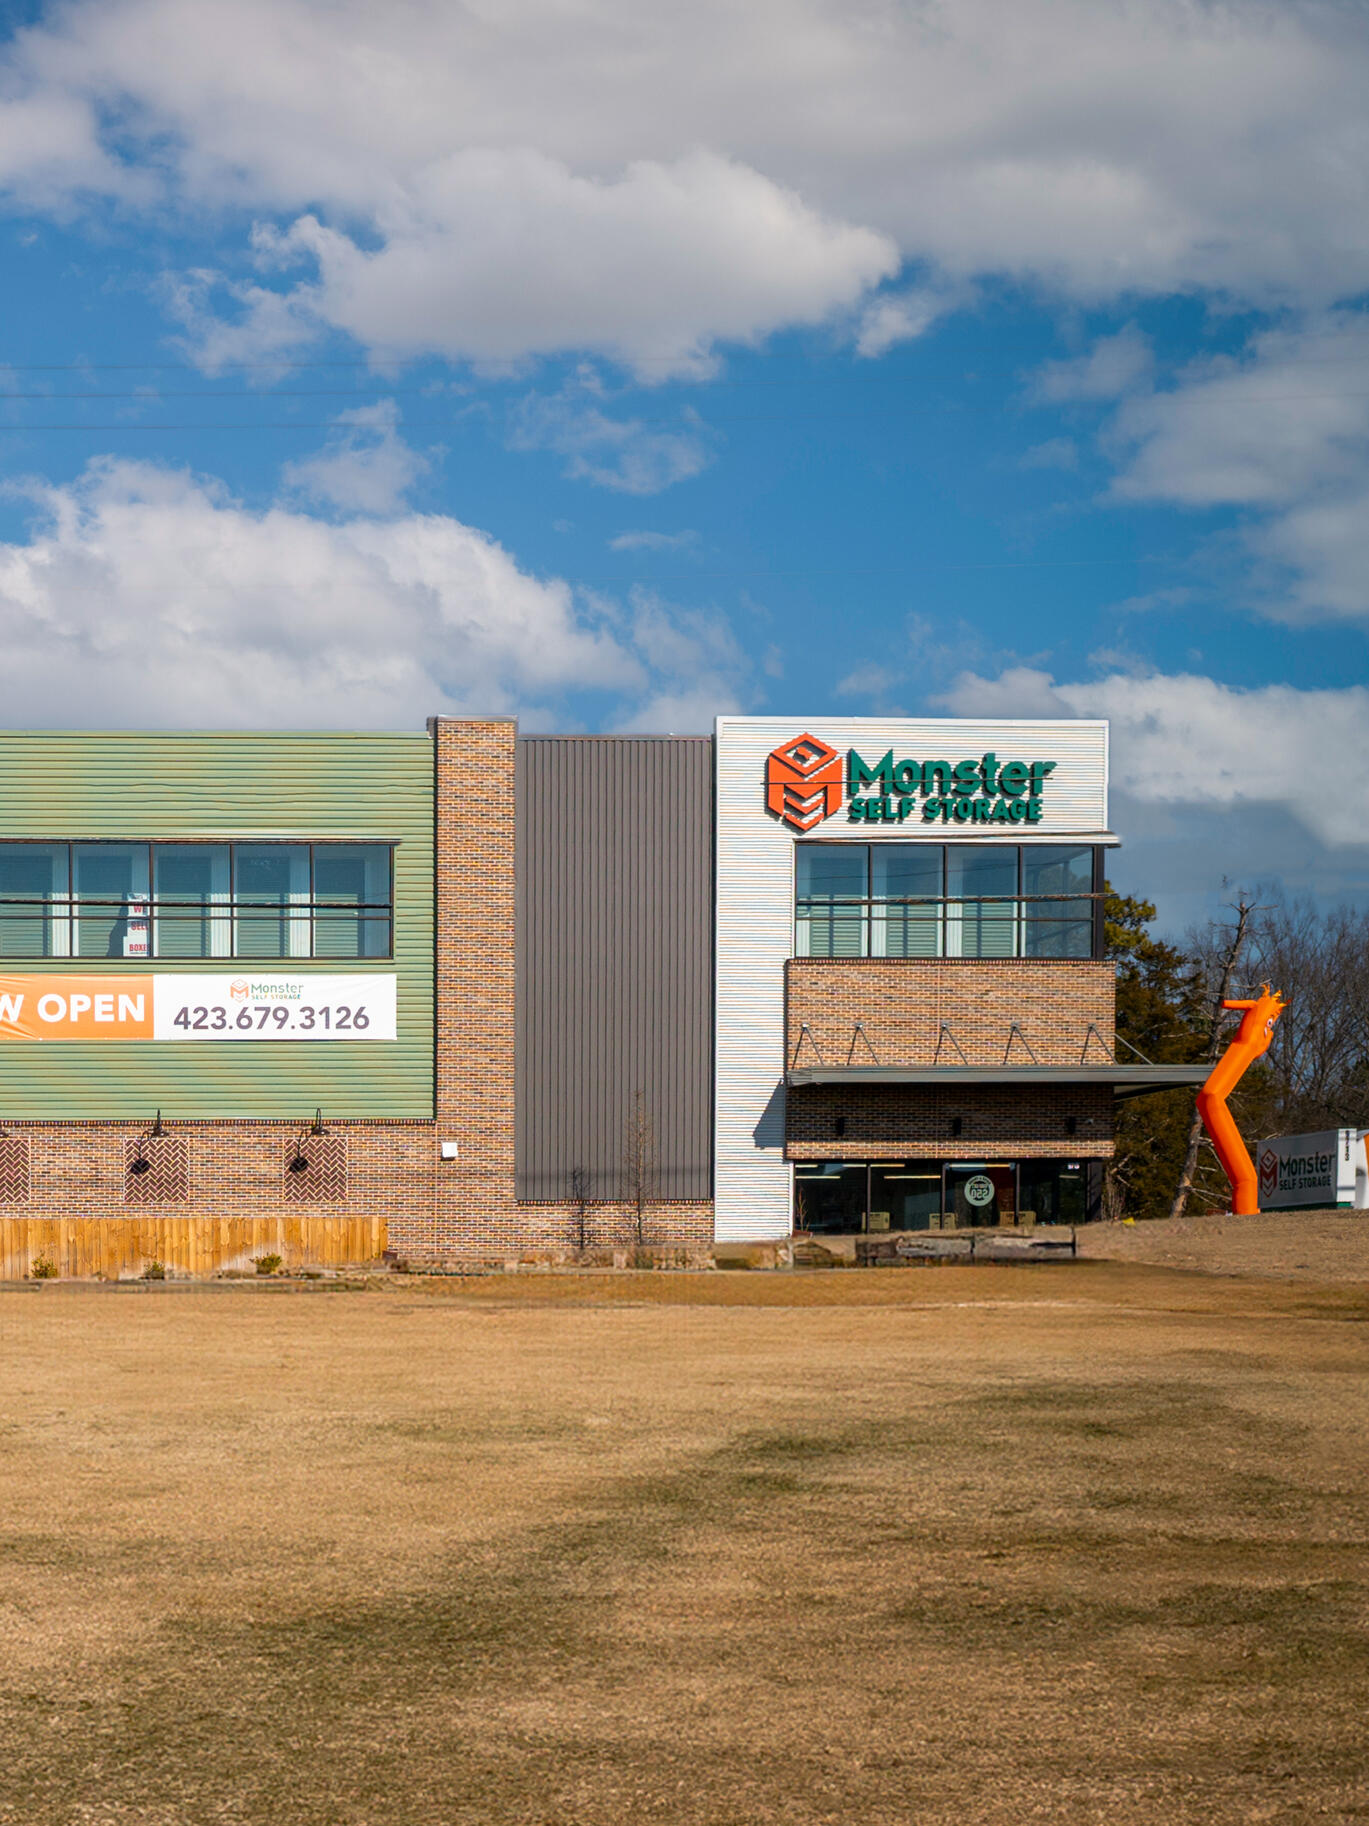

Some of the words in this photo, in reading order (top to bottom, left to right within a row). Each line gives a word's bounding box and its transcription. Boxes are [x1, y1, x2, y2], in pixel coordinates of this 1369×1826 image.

[849, 748, 1058, 796] Monster
[850, 797, 917, 820] SELF
[924, 797, 1044, 821] STORAGE
[250, 982, 304, 994] Monster
[37, 993, 145, 1022] OPEN
[173, 1006, 370, 1030] 423.679.3126
[1279, 1151, 1336, 1179] Monster
[1278, 1179, 1297, 1191] SELF
[1298, 1175, 1332, 1189] STORAGE
